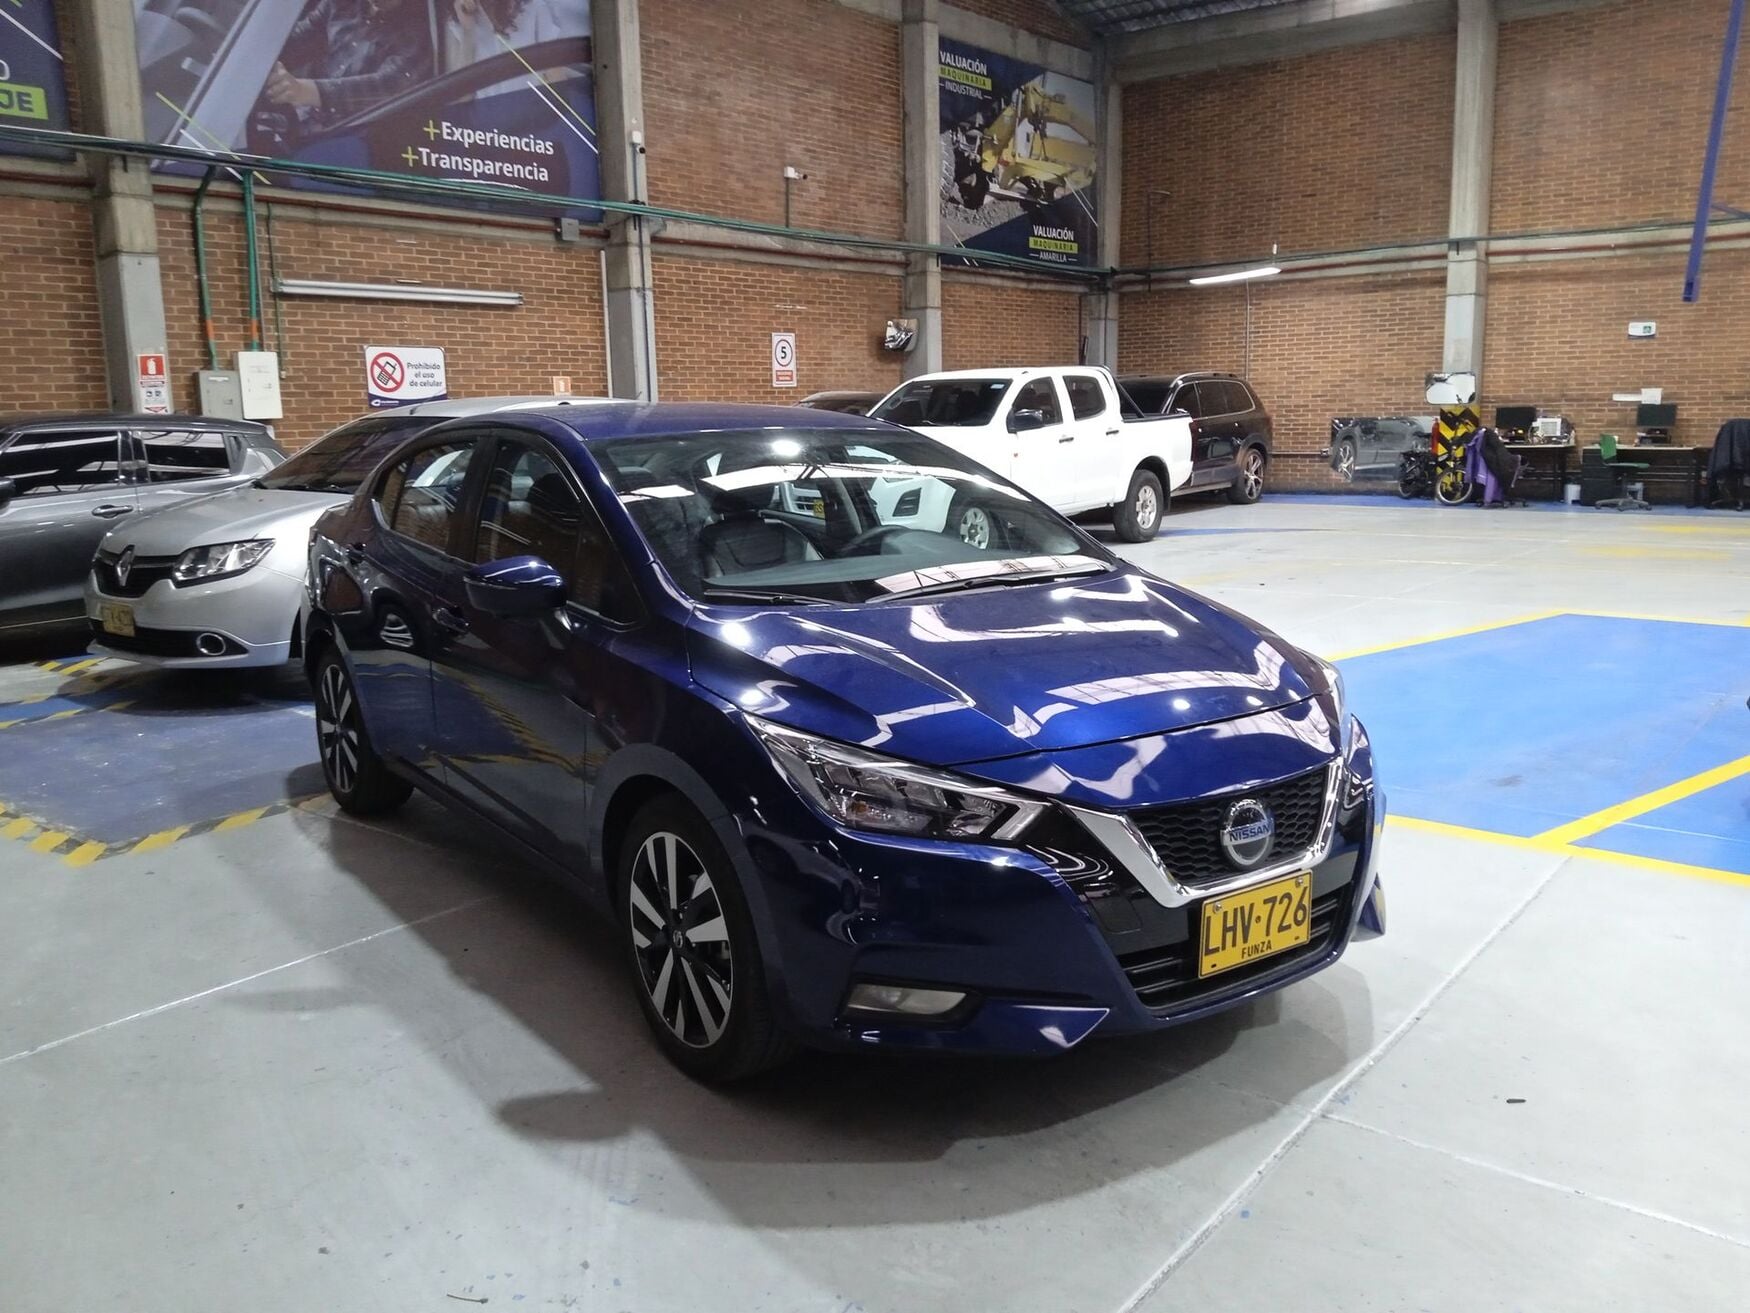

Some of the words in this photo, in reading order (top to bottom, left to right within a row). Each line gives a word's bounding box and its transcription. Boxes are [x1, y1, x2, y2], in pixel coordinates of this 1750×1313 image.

[940, 50, 987, 76] VALUACIÓN
[945, 81, 983, 100] INDUSTRIAL
[1032, 224, 1074, 241] VALUACIÓN
[1040, 251, 1067, 262] AMARILLA
[780, 346, 787, 359] 5
[407, 362, 440, 370] Prohibido
[414, 371, 421, 379] el
[1230, 824, 1270, 842] NISSAN
[1241, 939, 1272, 959] FUNZA
